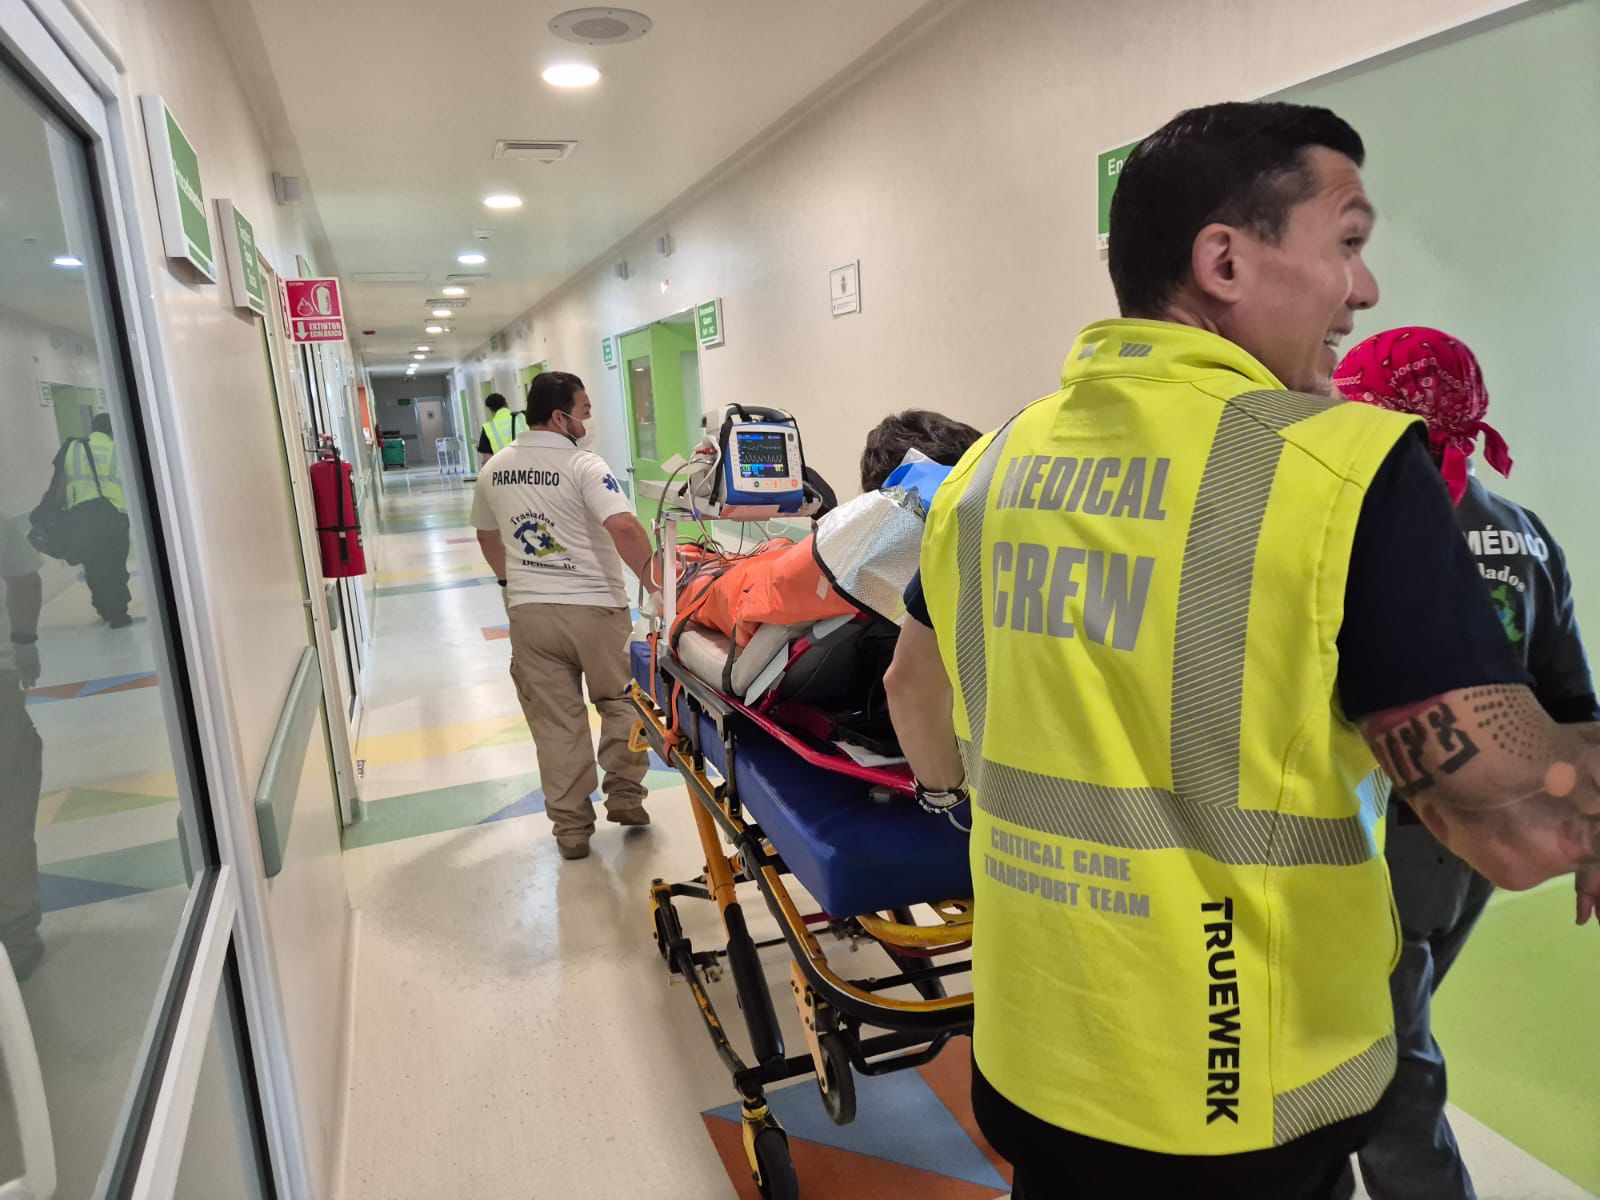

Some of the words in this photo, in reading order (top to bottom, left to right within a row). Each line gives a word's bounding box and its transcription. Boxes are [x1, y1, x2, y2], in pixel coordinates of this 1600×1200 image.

[492, 468, 560, 487] PARAMÉDICO
[996, 455, 1171, 521] MEDICAL
[510, 508, 555, 527] Traslados
[1462, 525, 1549, 562] MÉDICO
[992, 541, 1155, 652] CREW
[1477, 563, 1526, 592] lados
[991, 827, 1065, 870] CRITICAL
[1073, 850, 1131, 882] CARE
[984, 853, 1080, 906] TRANSPORT
[1088, 884, 1150, 918] TEAM
[1201, 896, 1241, 1125] TRUEWERK
